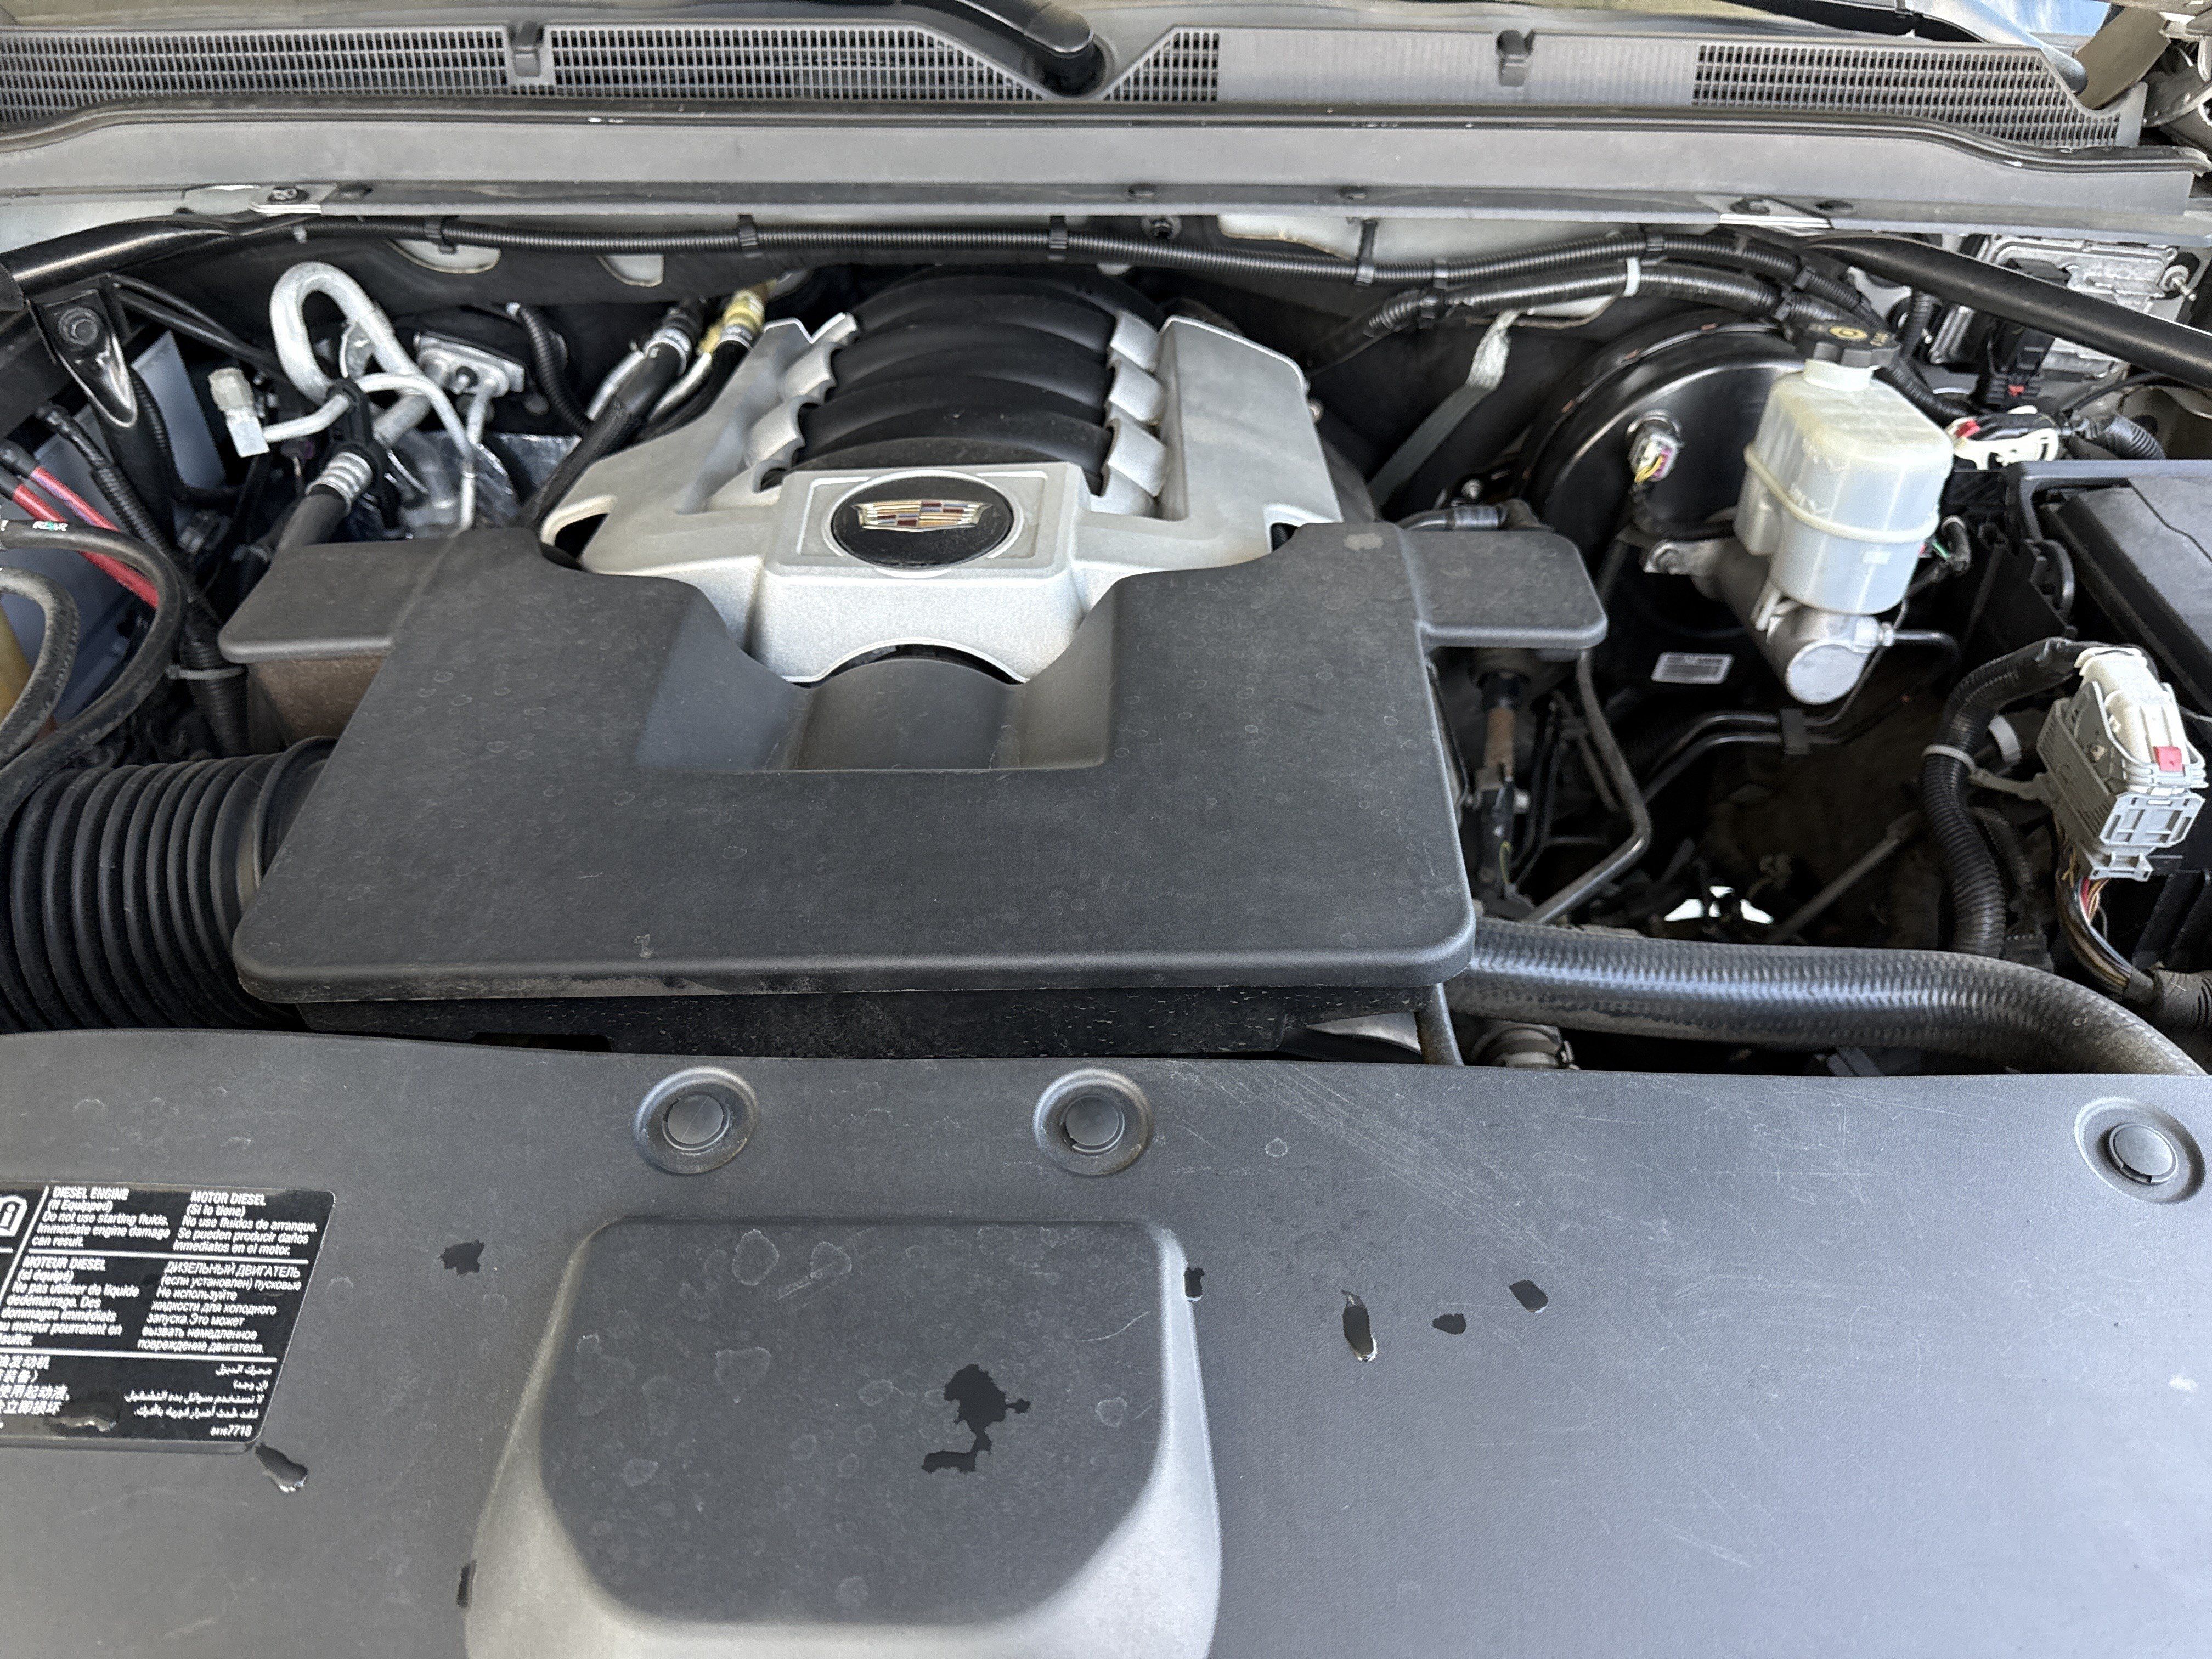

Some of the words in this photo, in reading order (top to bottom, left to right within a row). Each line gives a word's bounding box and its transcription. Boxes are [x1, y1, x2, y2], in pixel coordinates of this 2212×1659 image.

[53, 1186, 87, 1199] DIESEL
[90, 1187, 129, 1200] ENGINE
[190, 1190, 229, 1204] MOTOR
[230, 1193, 266, 1206] DIESEL
[61, 1200, 113, 1212] Equipped)
[186, 1204, 201, 1217] (Si
[202, 1205, 213, 1216] lo
[216, 1206, 246, 1218] tiene)
[42, 1210, 57, 1222] Do
[58, 1212, 76, 1222] not
[77, 1214, 95, 1223] use
[97, 1213, 137, 1226] starting
[138, 1214, 168, 1226] fluids.
[182, 1216, 196, 1227] No
[199, 1218, 217, 1228] use
[219, 1217, 253, 1229] fluidos
[255, 1219, 269, 1229] de
[270, 1221, 317, 1233] arranque.
[37, 1222, 91, 1235] Immediate
[93, 1226, 127, 1238] engine
[128, 1226, 170, 1239] damage
[178, 1227, 191, 1239] Se
[193, 1229, 232, 1242] pueden
[233, 1231, 277, 1243] producir
[278, 1232, 309, 1244] daños
[32, 1236, 52, 1246] can
[53, 1236, 84, 1248] result.
[173, 1239, 230, 1253] inmediatos
[232, 1244, 245, 1254] en
[246, 1243, 257, 1254] el
[259, 1244, 290, 1256] motor.
[22, 1255, 68, 1269] MOTEUR
[69, 1257, 106, 1271] DIESEL
[165, 1261, 235, 1276] ДИЗЕЛЬНЫЙ
[236, 1265, 301, 1278] ДВИГАТЕЛЬ
[17, 1269, 33, 1282] (si
[33, 1269, 74, 1283] équipé)
[12, 1282, 27, 1294] Ne
[28, 1284, 48, 1295] pas
[50, 1283, 87, 1295] utiliser
[88, 1284, 102, 1295] de
[104, 1284, 139, 1297] liquide
[161, 1276, 190, 1287] (если
[191, 1278, 252, 1290] установлен)
[254, 1280, 302, 1293] пусковые
[156, 1286, 171, 1298] Не
[173, 1289, 238, 1301] используйте
[80, 1296, 101, 1308] Des
[151, 1301, 200, 1313] жидкости
[201, 1304, 222, 1314] для
[223, 1305, 276, 1316] холодного
[1, 1307, 59, 1322] dommages
[211, 1316, 245, 1327] может
[12, 1321, 50, 1333] moteur
[49, 1323, 107, 1336] pourraient
[108, 1325, 122, 1336] en
[142, 1325, 184, 1338] вызвать
[187, 1328, 257, 1341] немедленное
[0, 1333, 33, 1346] sulter.
[137, 1338, 207, 1352] повреждение
[207, 1342, 264, 1355] двигателя.
[216, 1363, 244, 1376] الديزل
[244, 1365, 272, 1376] محرك
[256, 1393, 264, 1404] لا
